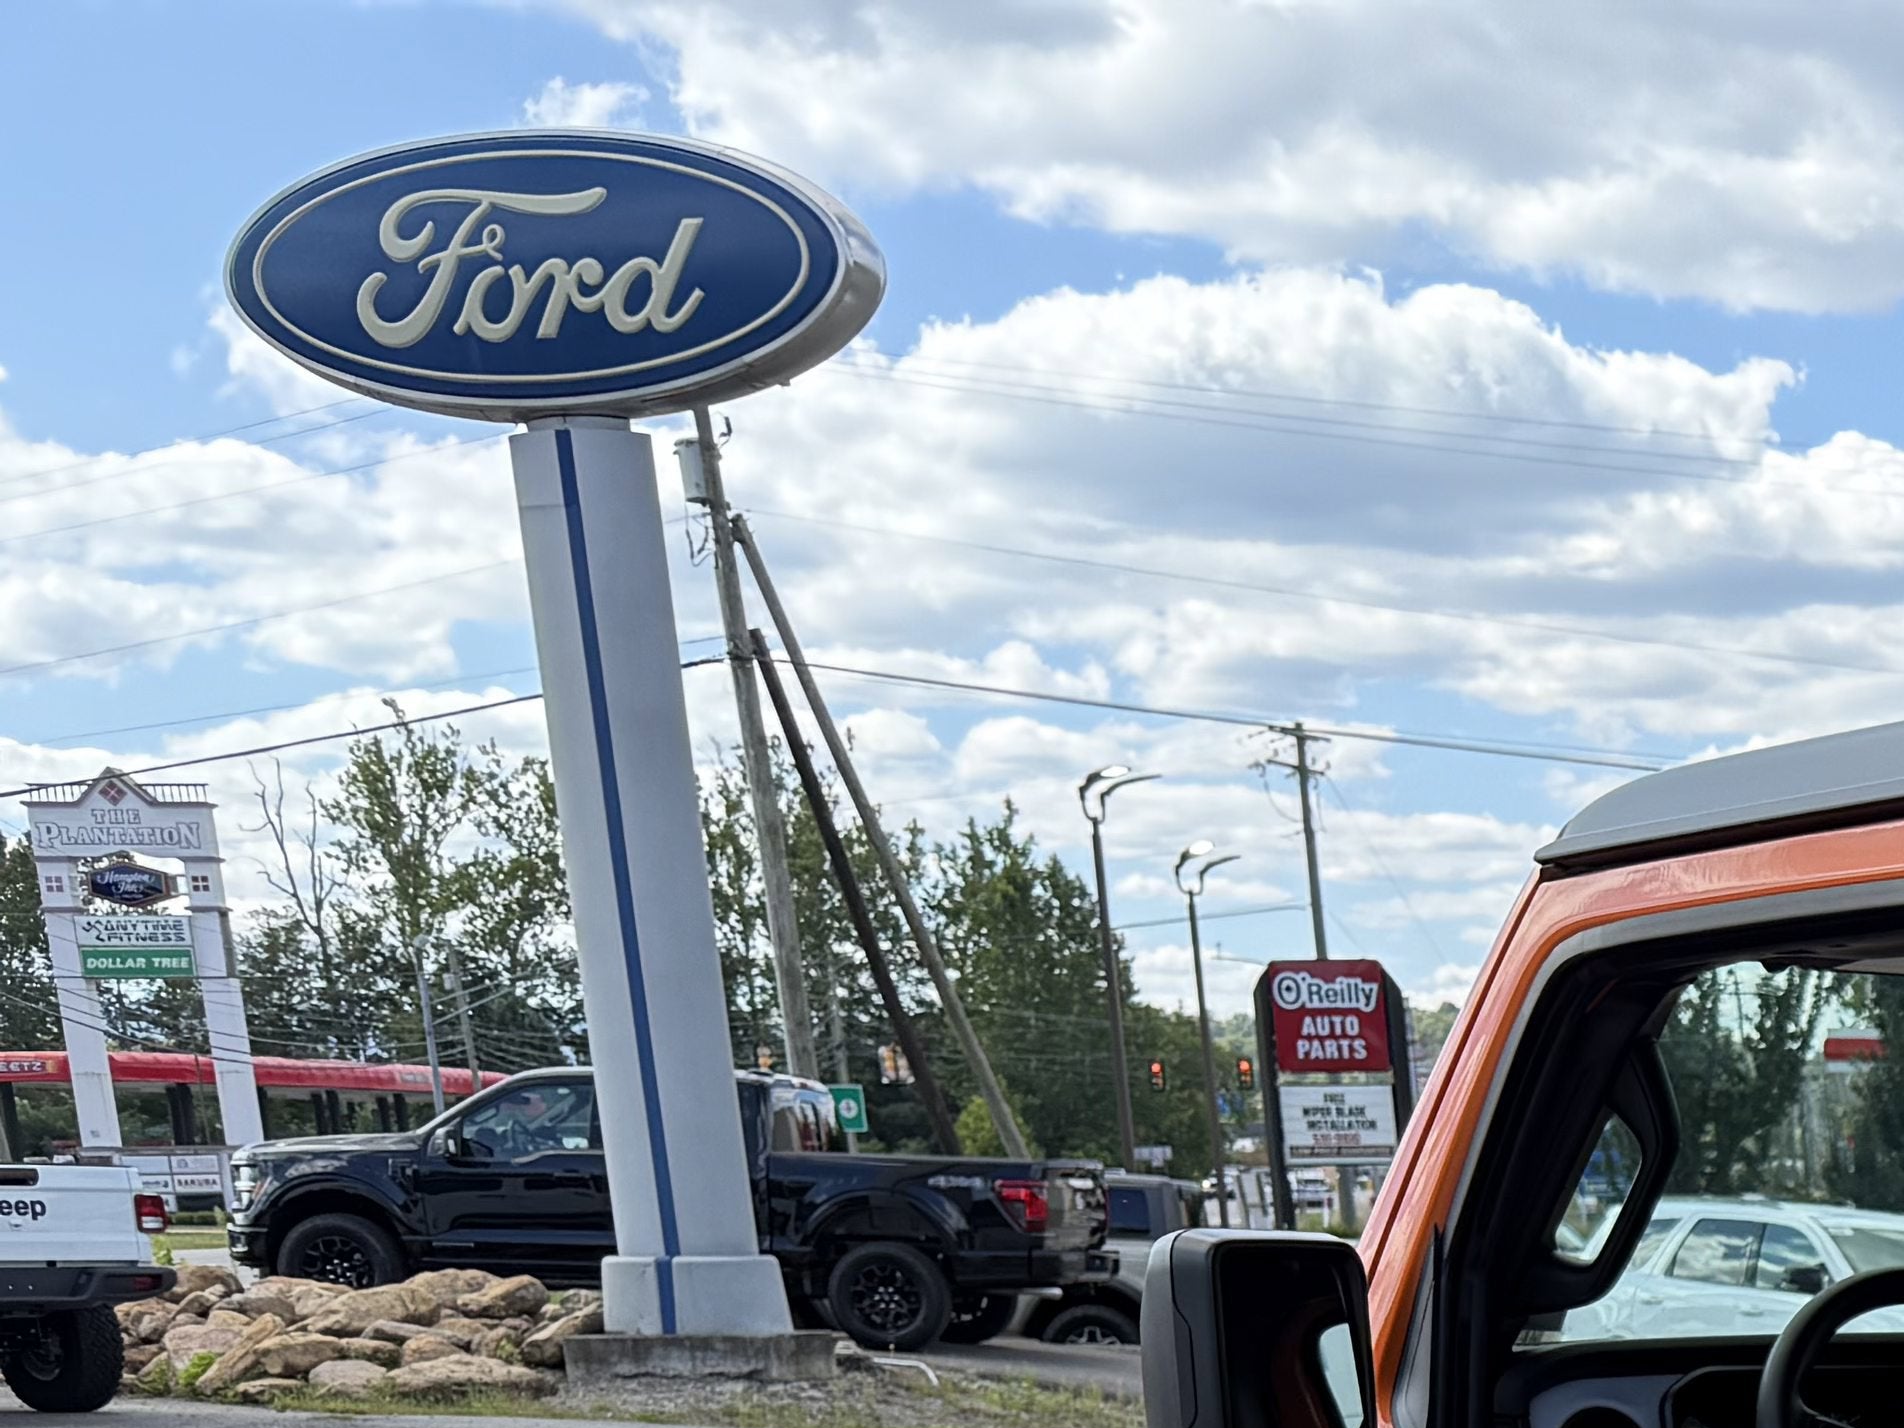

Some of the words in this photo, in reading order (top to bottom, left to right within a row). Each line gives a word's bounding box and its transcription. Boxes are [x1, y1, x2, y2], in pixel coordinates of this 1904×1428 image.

[356, 186, 705, 349] Ford
[91, 809, 141, 825] THE
[35, 822, 201, 850] PLANTATION
[96, 870, 156, 885] Hampton
[104, 919, 184, 931] ANYTIME
[106, 932, 186, 942] FITNESS
[86, 957, 146, 969] DOLLAR
[152, 957, 190, 969] TREE
[1275, 974, 1376, 1009] O'Reilly
[1301, 1015, 1360, 1036] AUTO
[1296, 1039, 1369, 1060] PARTS
